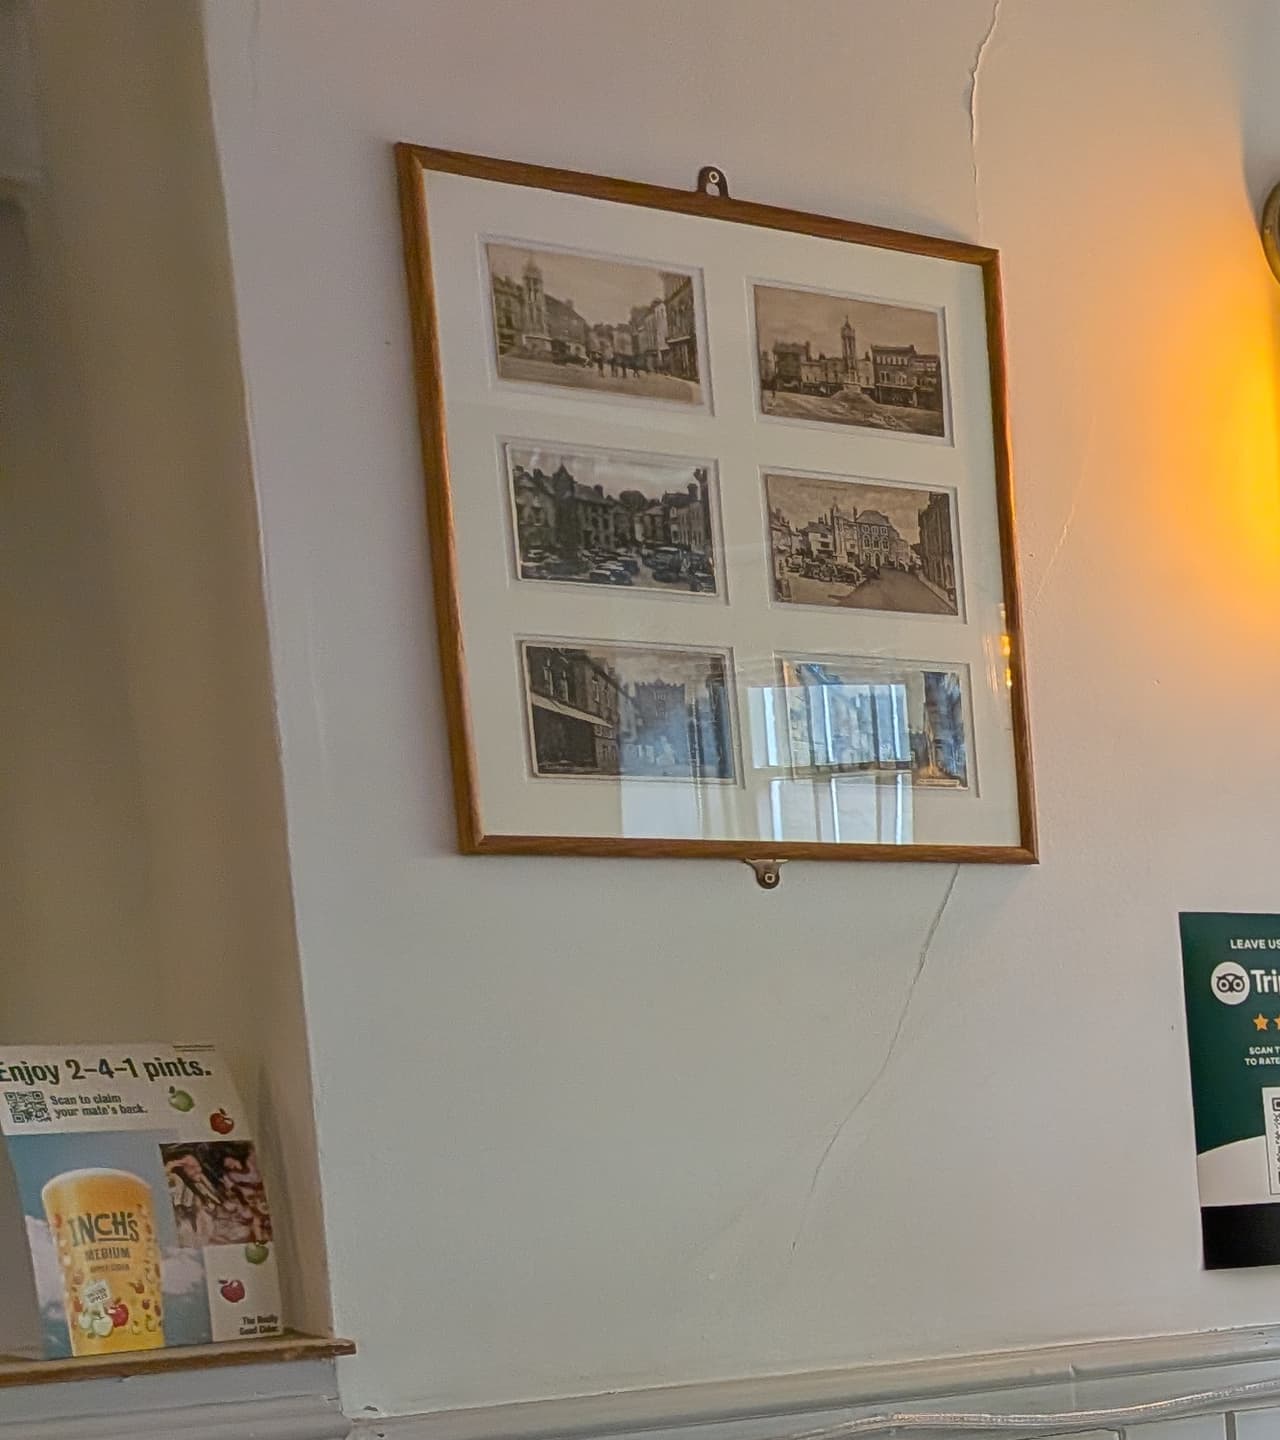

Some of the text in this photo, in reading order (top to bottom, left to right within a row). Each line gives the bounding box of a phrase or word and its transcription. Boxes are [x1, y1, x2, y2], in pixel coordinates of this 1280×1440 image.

[1230, 939, 1266, 949] LEAVE
[1249, 1047, 1273, 1055] SCAN
[1244, 1058, 1257, 1066] TO
[1259, 1056, 1280, 1065] RATE
[0, 1061, 60, 1085] Enjoy
[143, 1057, 212, 1081] pints.
[50, 1093, 122, 1106] Scan to claim
[55, 1108, 80, 1120] your
[119, 1102, 149, 1114] back.
